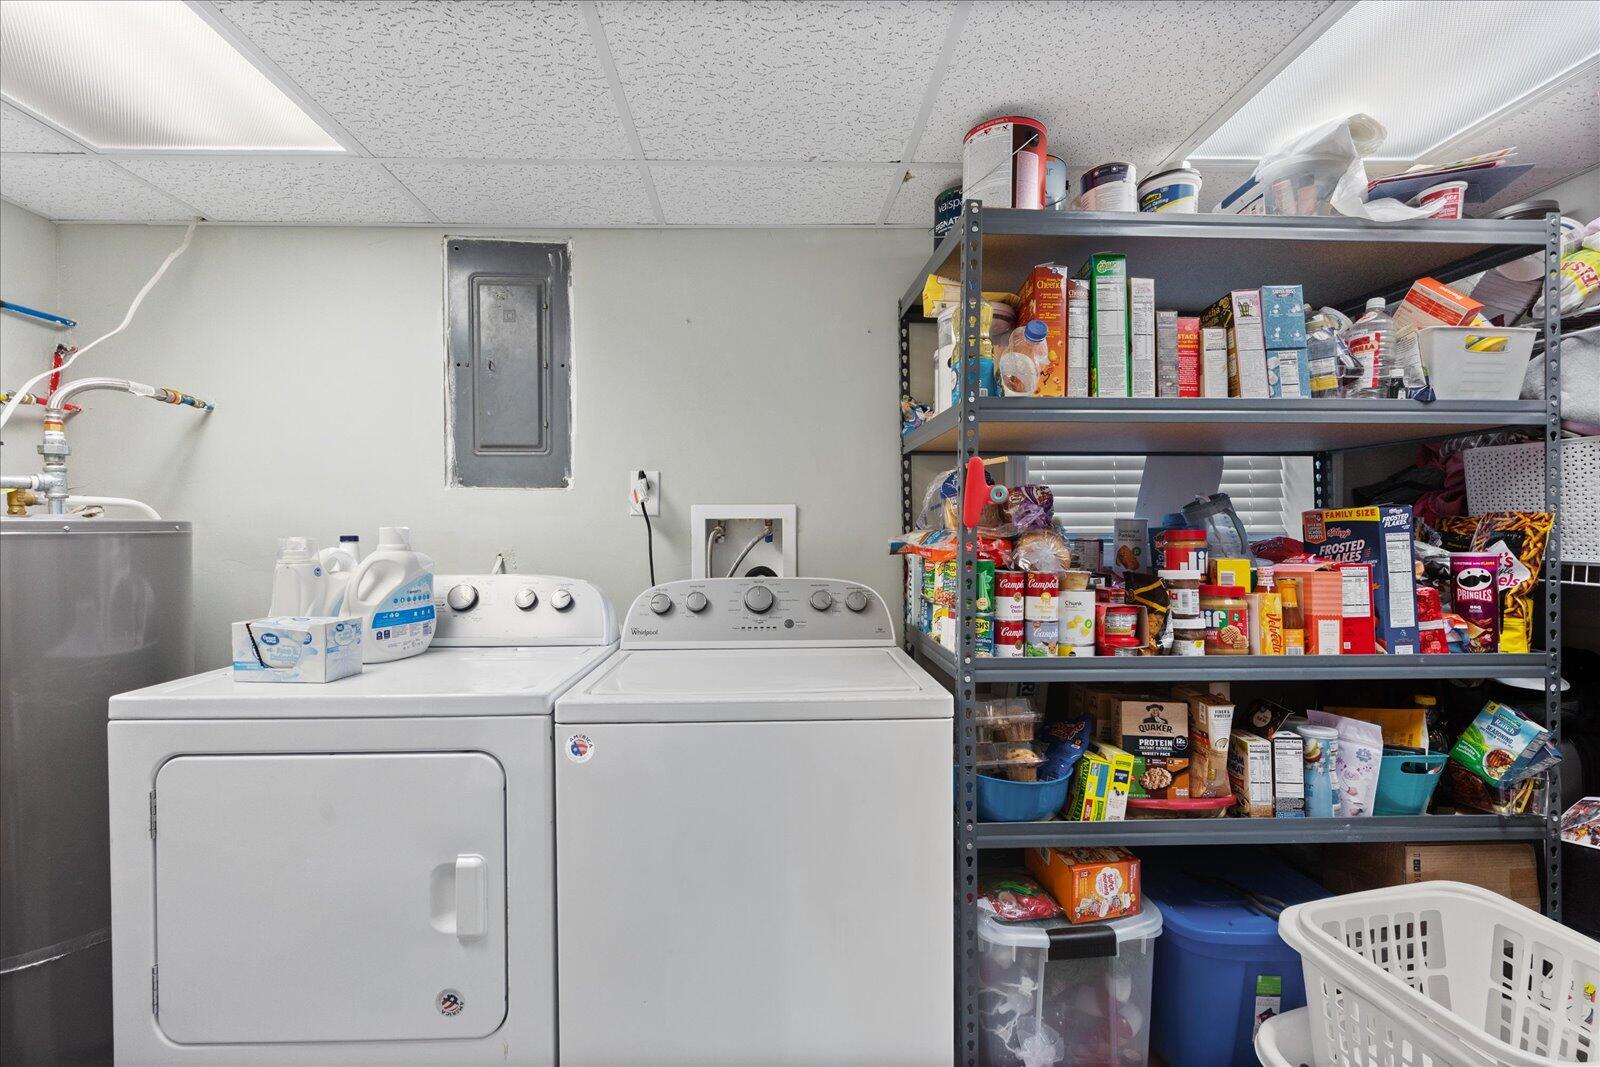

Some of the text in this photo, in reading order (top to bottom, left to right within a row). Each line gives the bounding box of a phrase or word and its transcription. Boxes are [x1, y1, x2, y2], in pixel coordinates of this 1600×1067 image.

[1325, 508, 1376, 519] FAMILY SIZE
[1319, 539, 1366, 556] FROSTED
[1457, 588, 1493, 602] PRINGLES
[631, 627, 659, 637] Whirlpool
[1266, 612, 1284, 654] Velveeta
[1138, 723, 1172, 733] QUAKER
[1494, 719, 1515, 736] Ranch
[570, 734, 593, 749] AMERICA
[1486, 725, 1514, 745] SEASONING
[1139, 738, 1173, 747] PROTEIN
